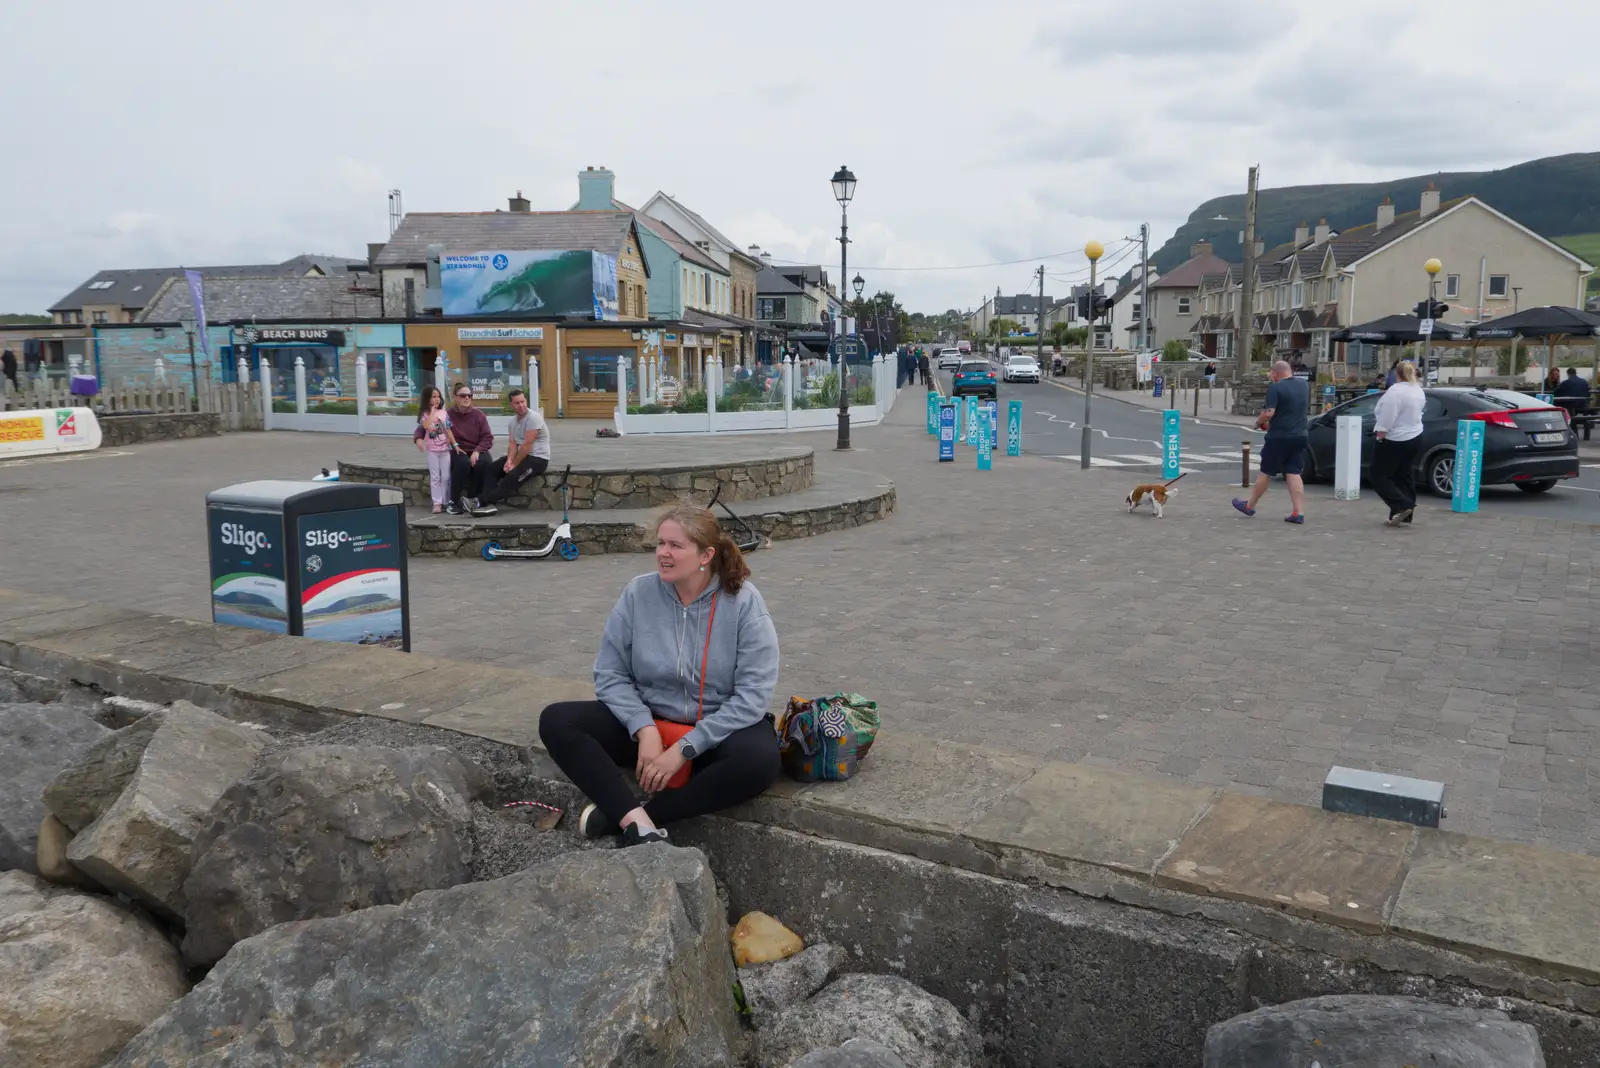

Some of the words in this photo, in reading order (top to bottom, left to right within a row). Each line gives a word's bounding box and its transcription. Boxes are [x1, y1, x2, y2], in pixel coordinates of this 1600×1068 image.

[262, 330, 296, 339] BEACH
[299, 329, 328, 339] BUNS
[1168, 434, 1179, 469] OPEN
[1468, 450, 1479, 498] Seafood
